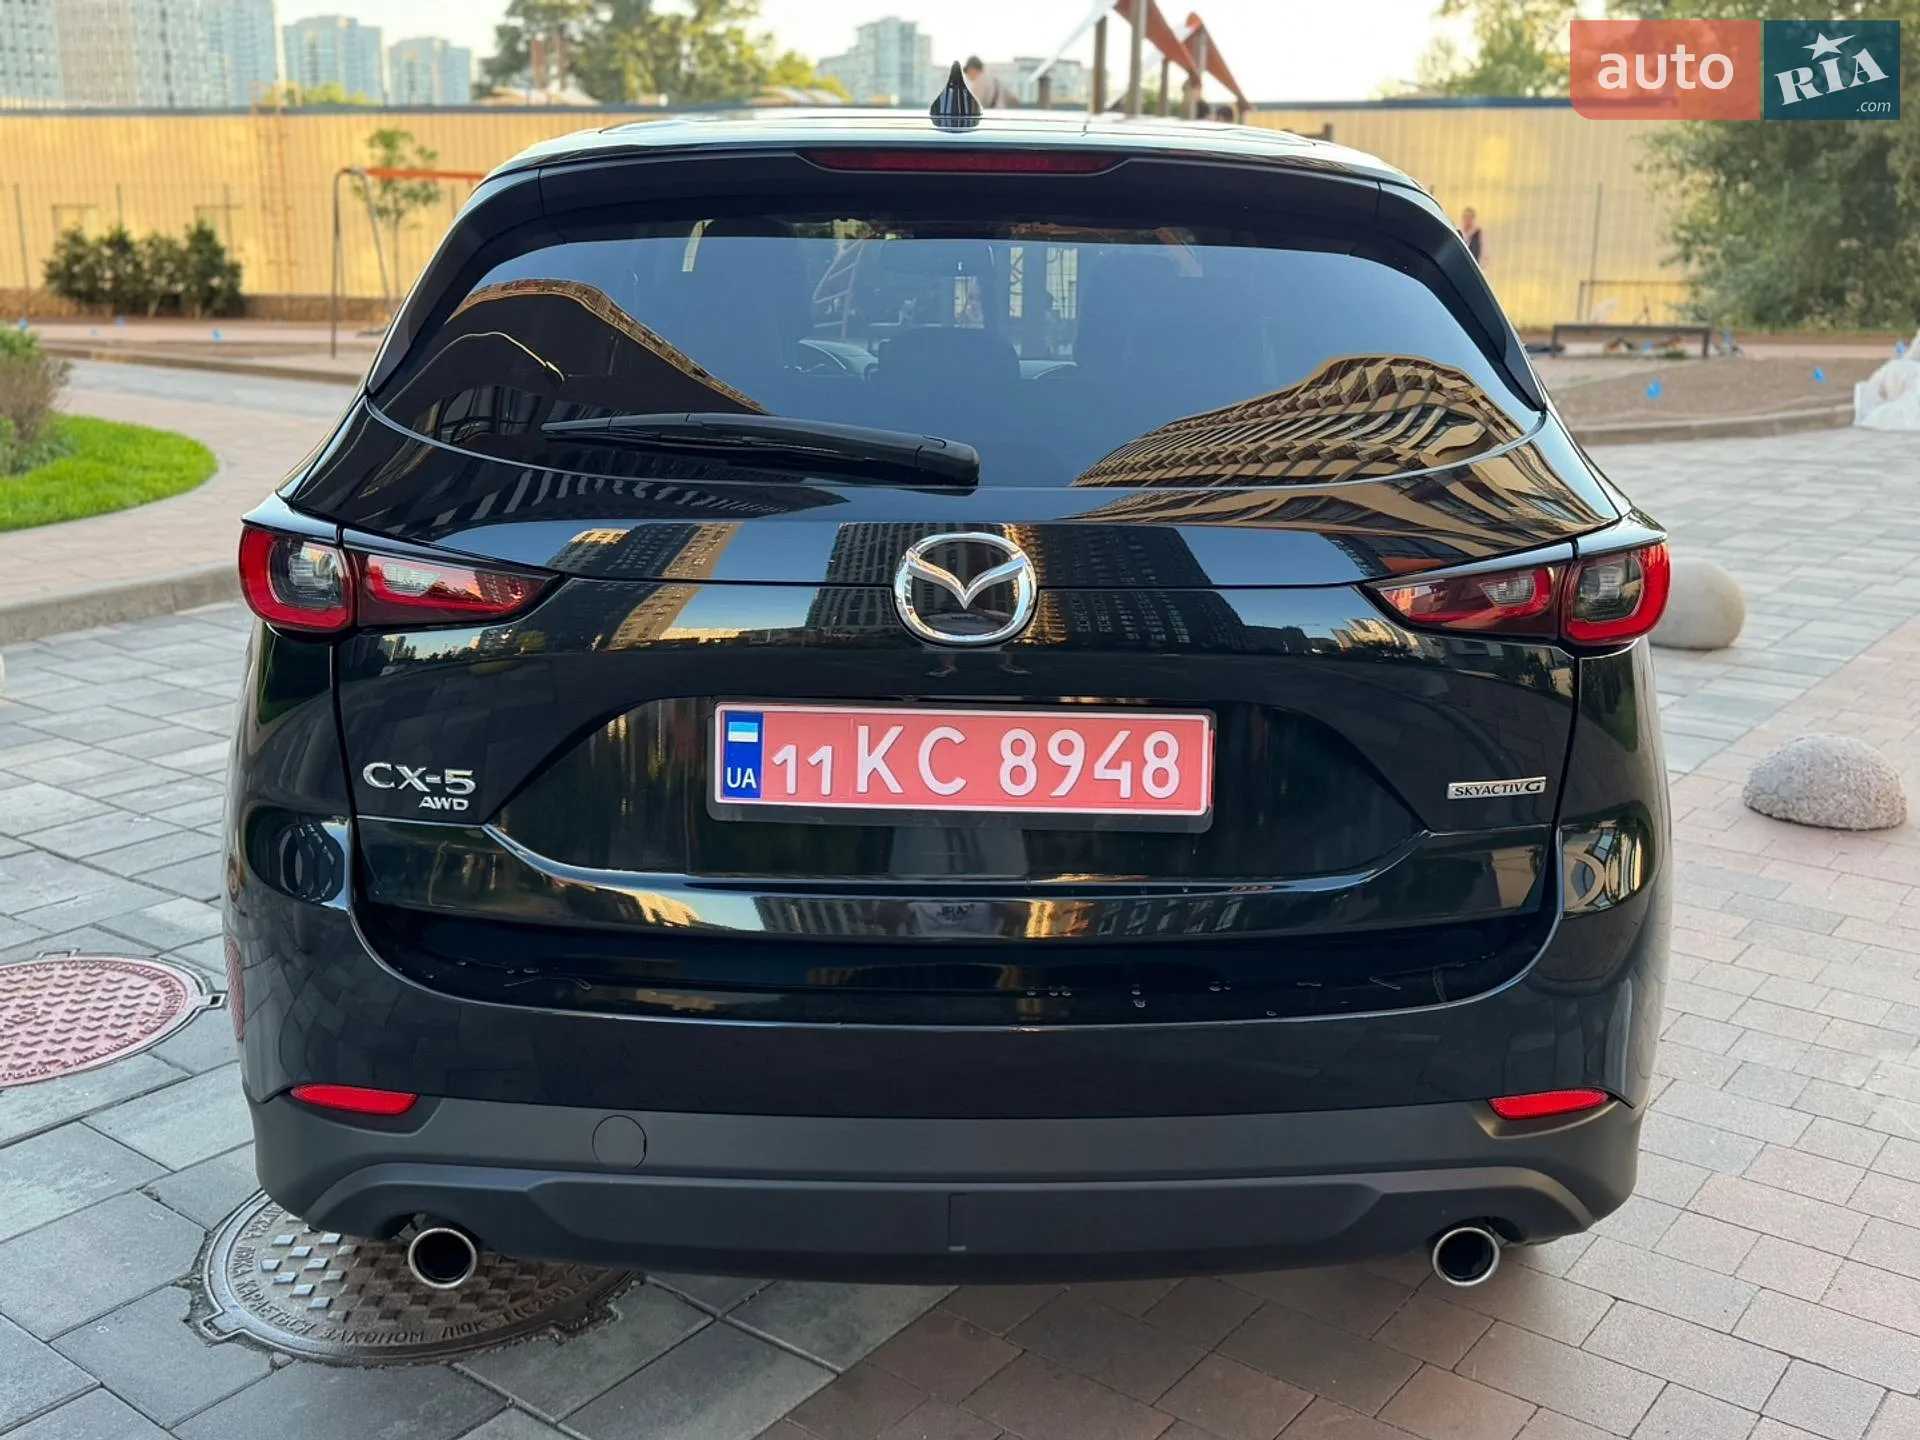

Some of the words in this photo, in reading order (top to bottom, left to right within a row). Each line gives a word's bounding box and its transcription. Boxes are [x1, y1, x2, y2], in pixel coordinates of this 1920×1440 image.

[771, 743, 834, 796] 11
[999, 727, 1181, 799] 8948
[362, 761, 477, 796] CX-5
[726, 767, 757, 789] UA
[418, 796, 470, 811] AWD
